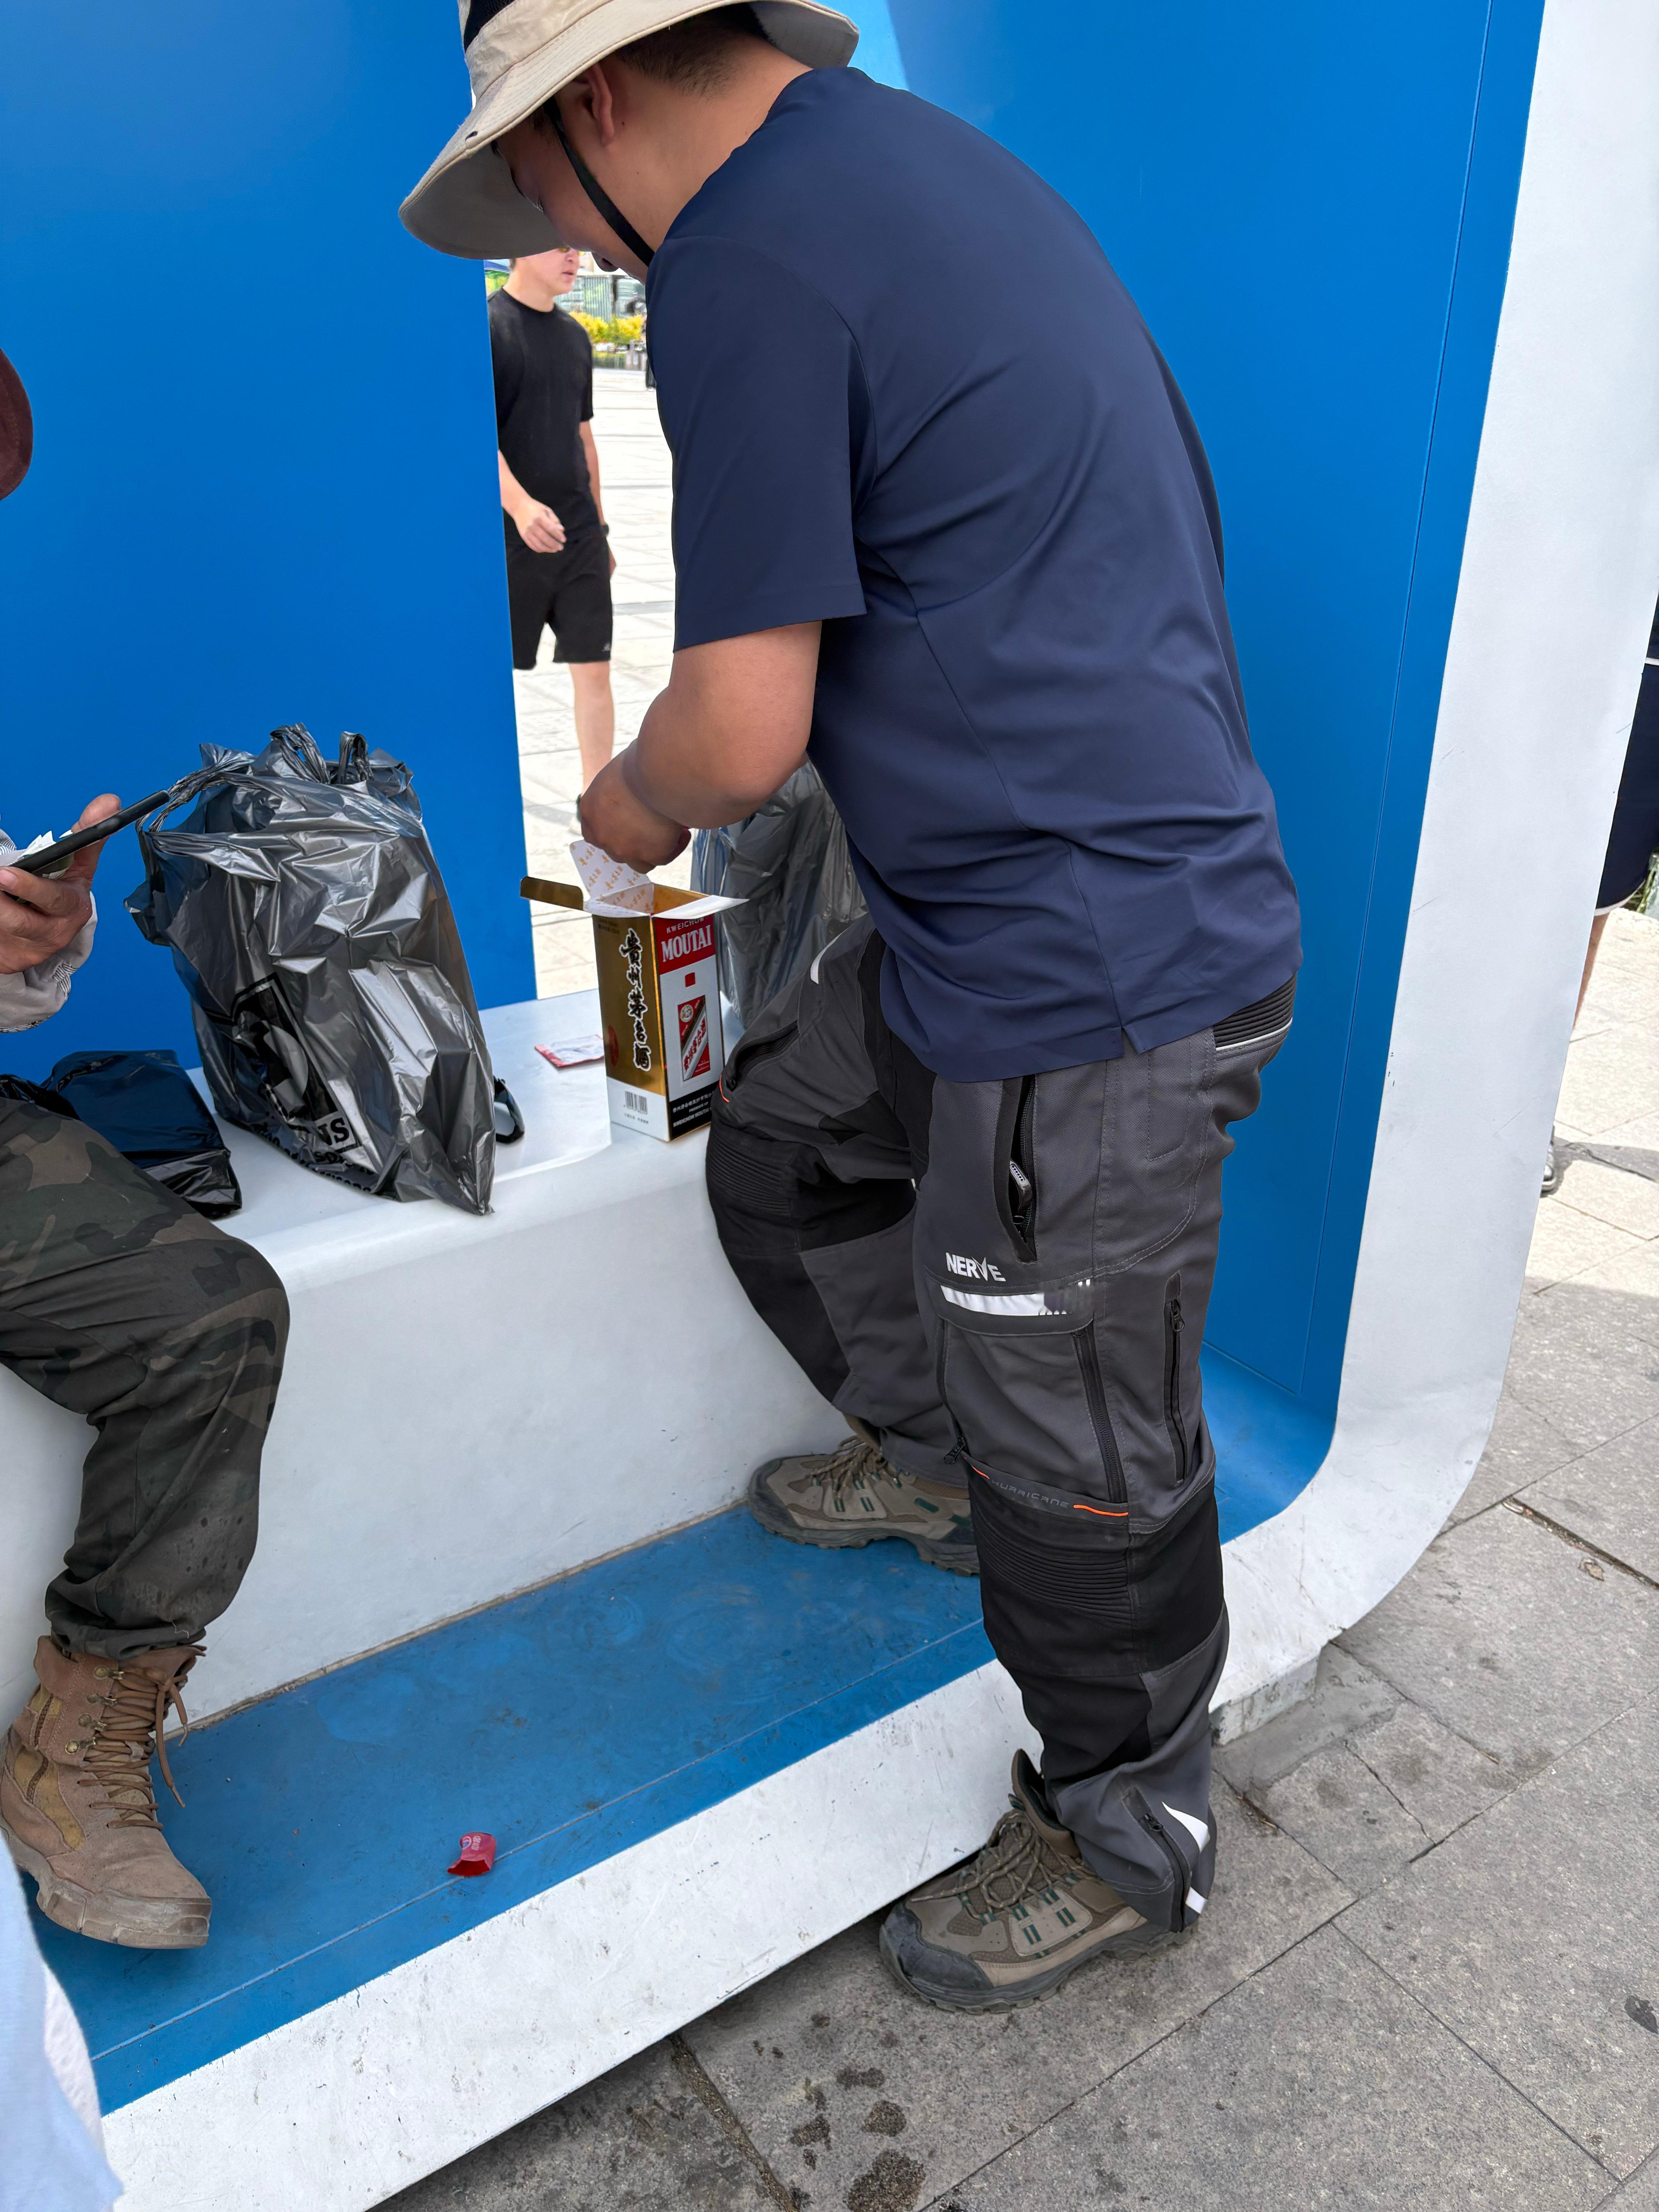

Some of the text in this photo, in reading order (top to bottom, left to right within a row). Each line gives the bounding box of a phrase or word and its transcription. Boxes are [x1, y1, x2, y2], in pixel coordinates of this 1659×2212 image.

[666, 916, 704, 934] KWEICHOW
[661, 925, 712, 962] MOUTAI
[945, 1252, 1006, 1282] NERVE
[992, 1479, 1069, 1508] HURRICANE
